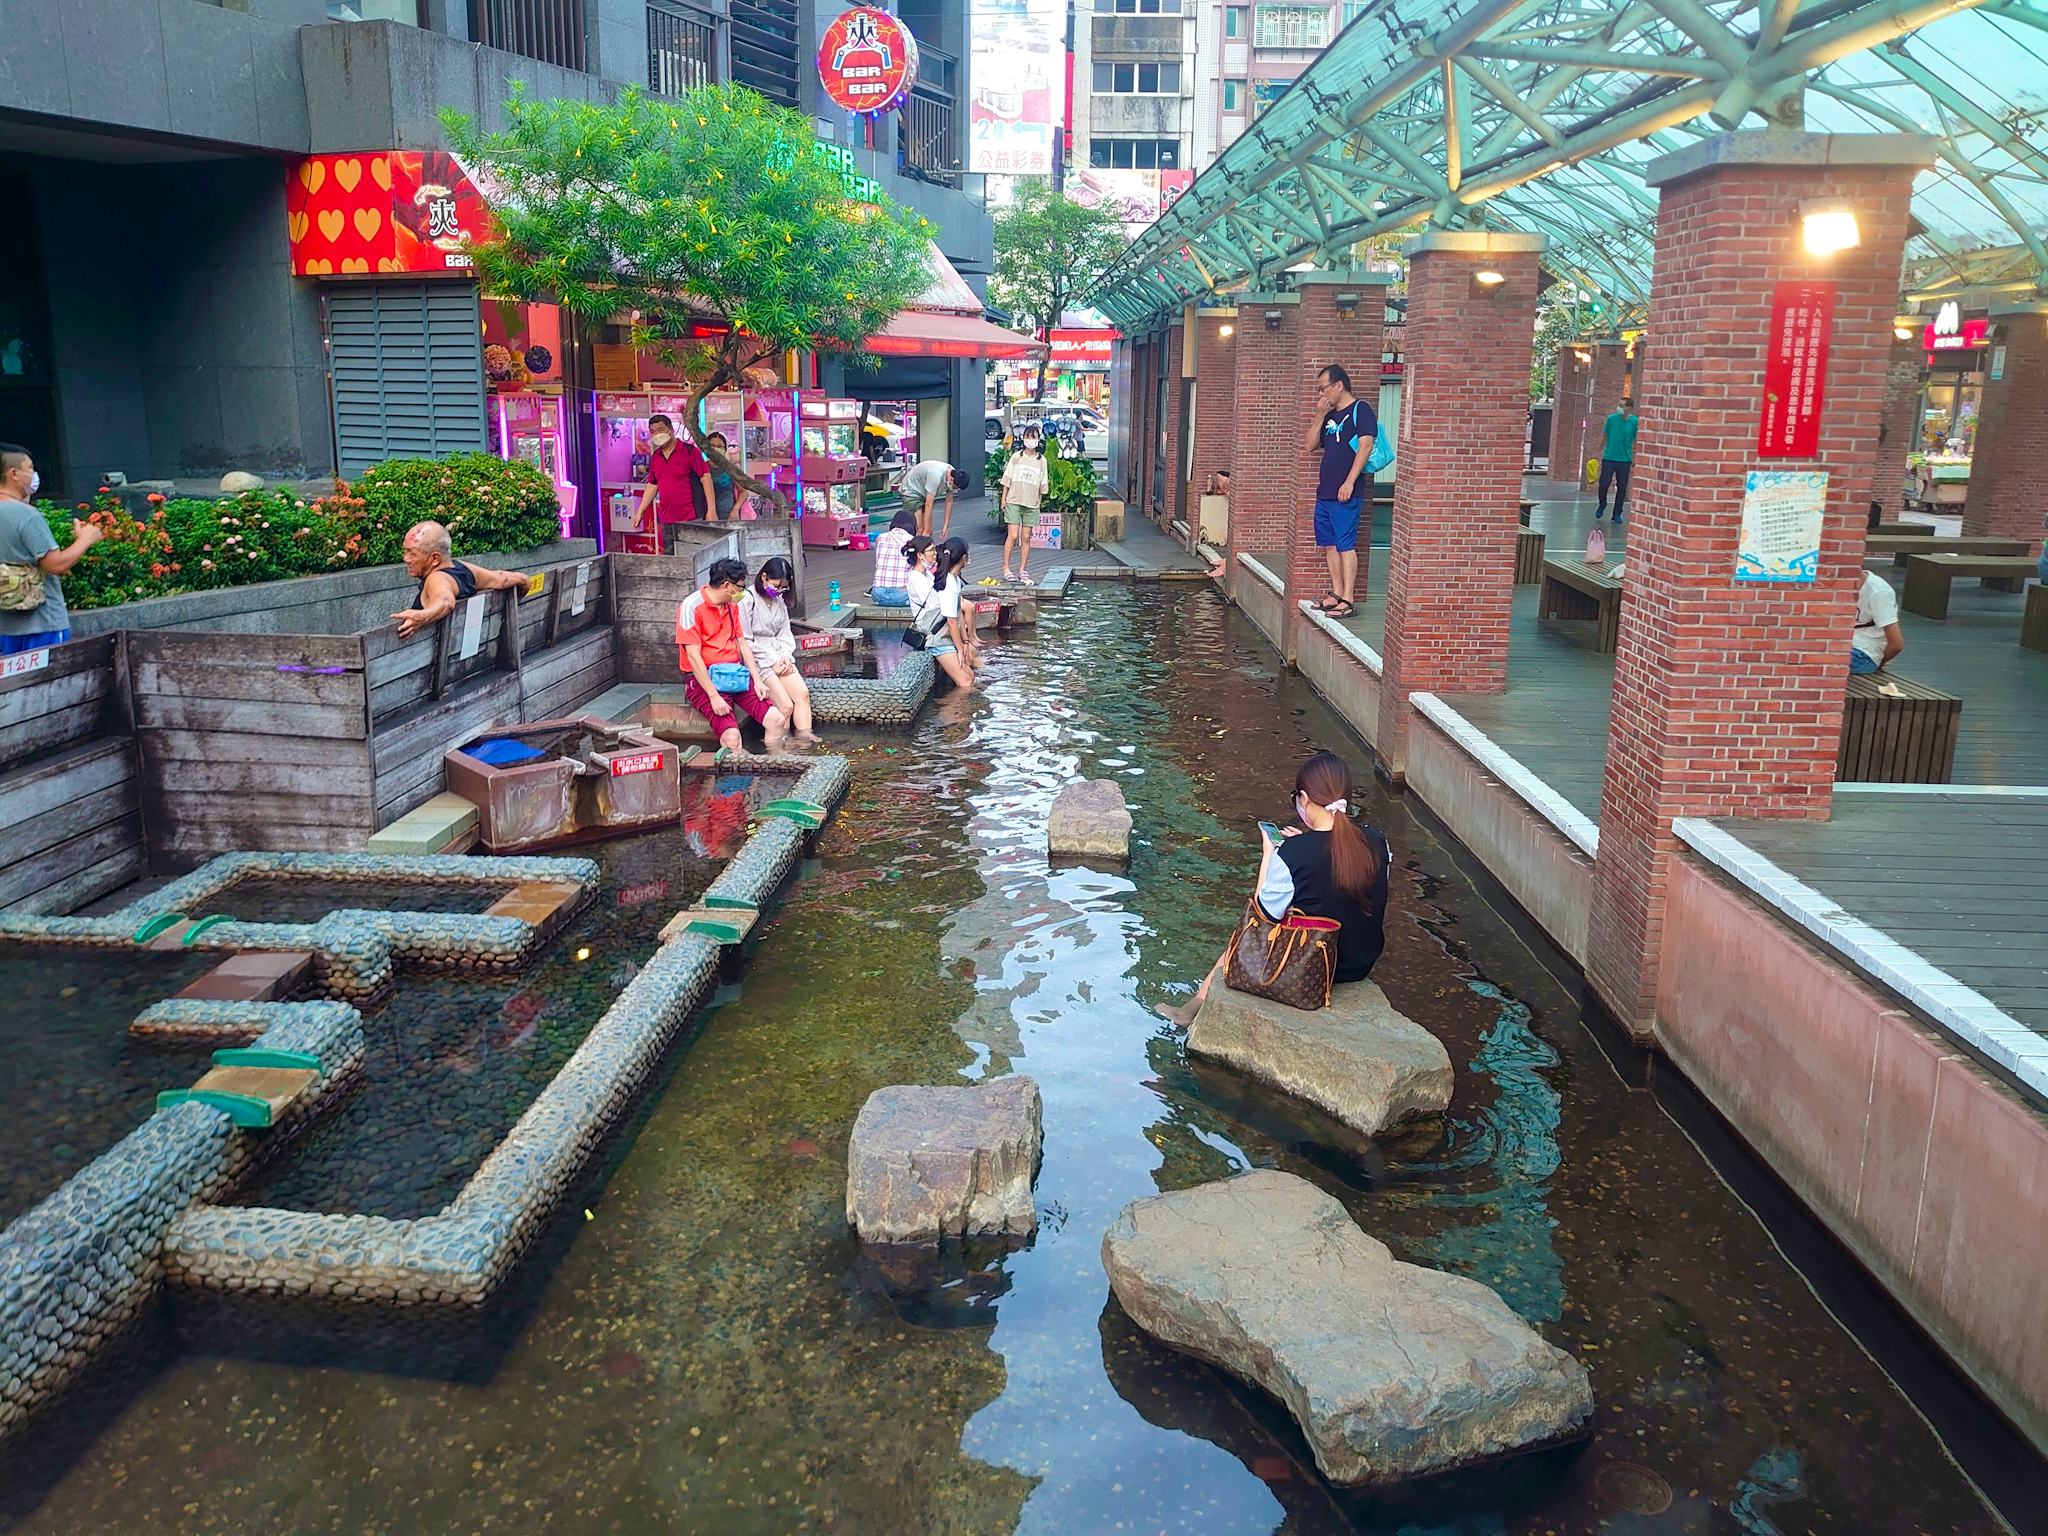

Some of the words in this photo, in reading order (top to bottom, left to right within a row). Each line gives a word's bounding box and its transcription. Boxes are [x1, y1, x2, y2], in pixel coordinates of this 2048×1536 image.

[977, 149, 1046, 169] 公益彩券
[429, 199, 459, 236] 夾
